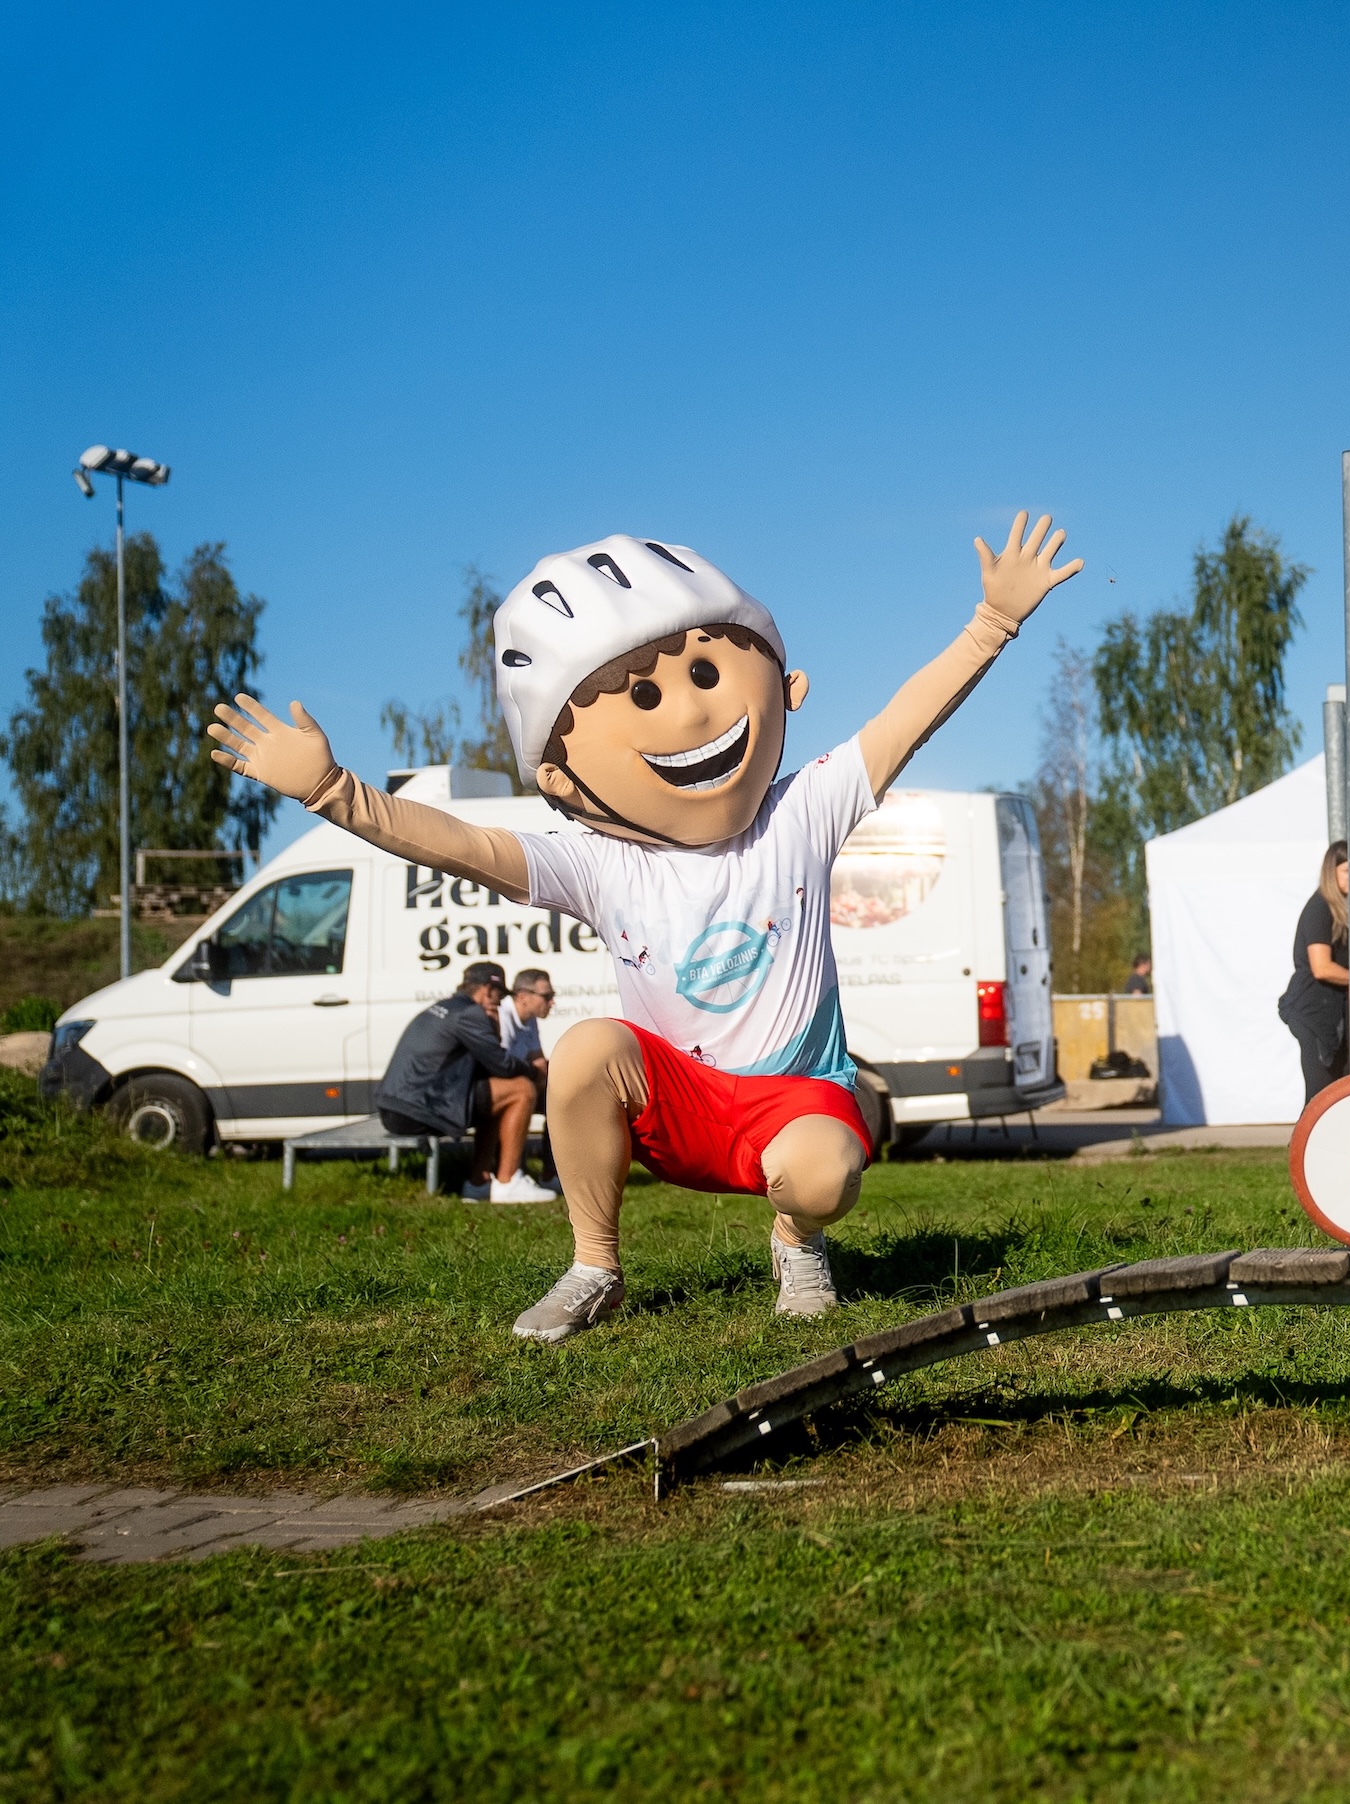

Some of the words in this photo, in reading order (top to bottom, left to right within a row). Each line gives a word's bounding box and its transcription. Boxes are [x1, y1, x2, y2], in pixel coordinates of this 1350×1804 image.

[418, 910, 612, 971] garde
[690, 966, 709, 981] BTA
[710, 946, 759, 976] VELOZINIS
